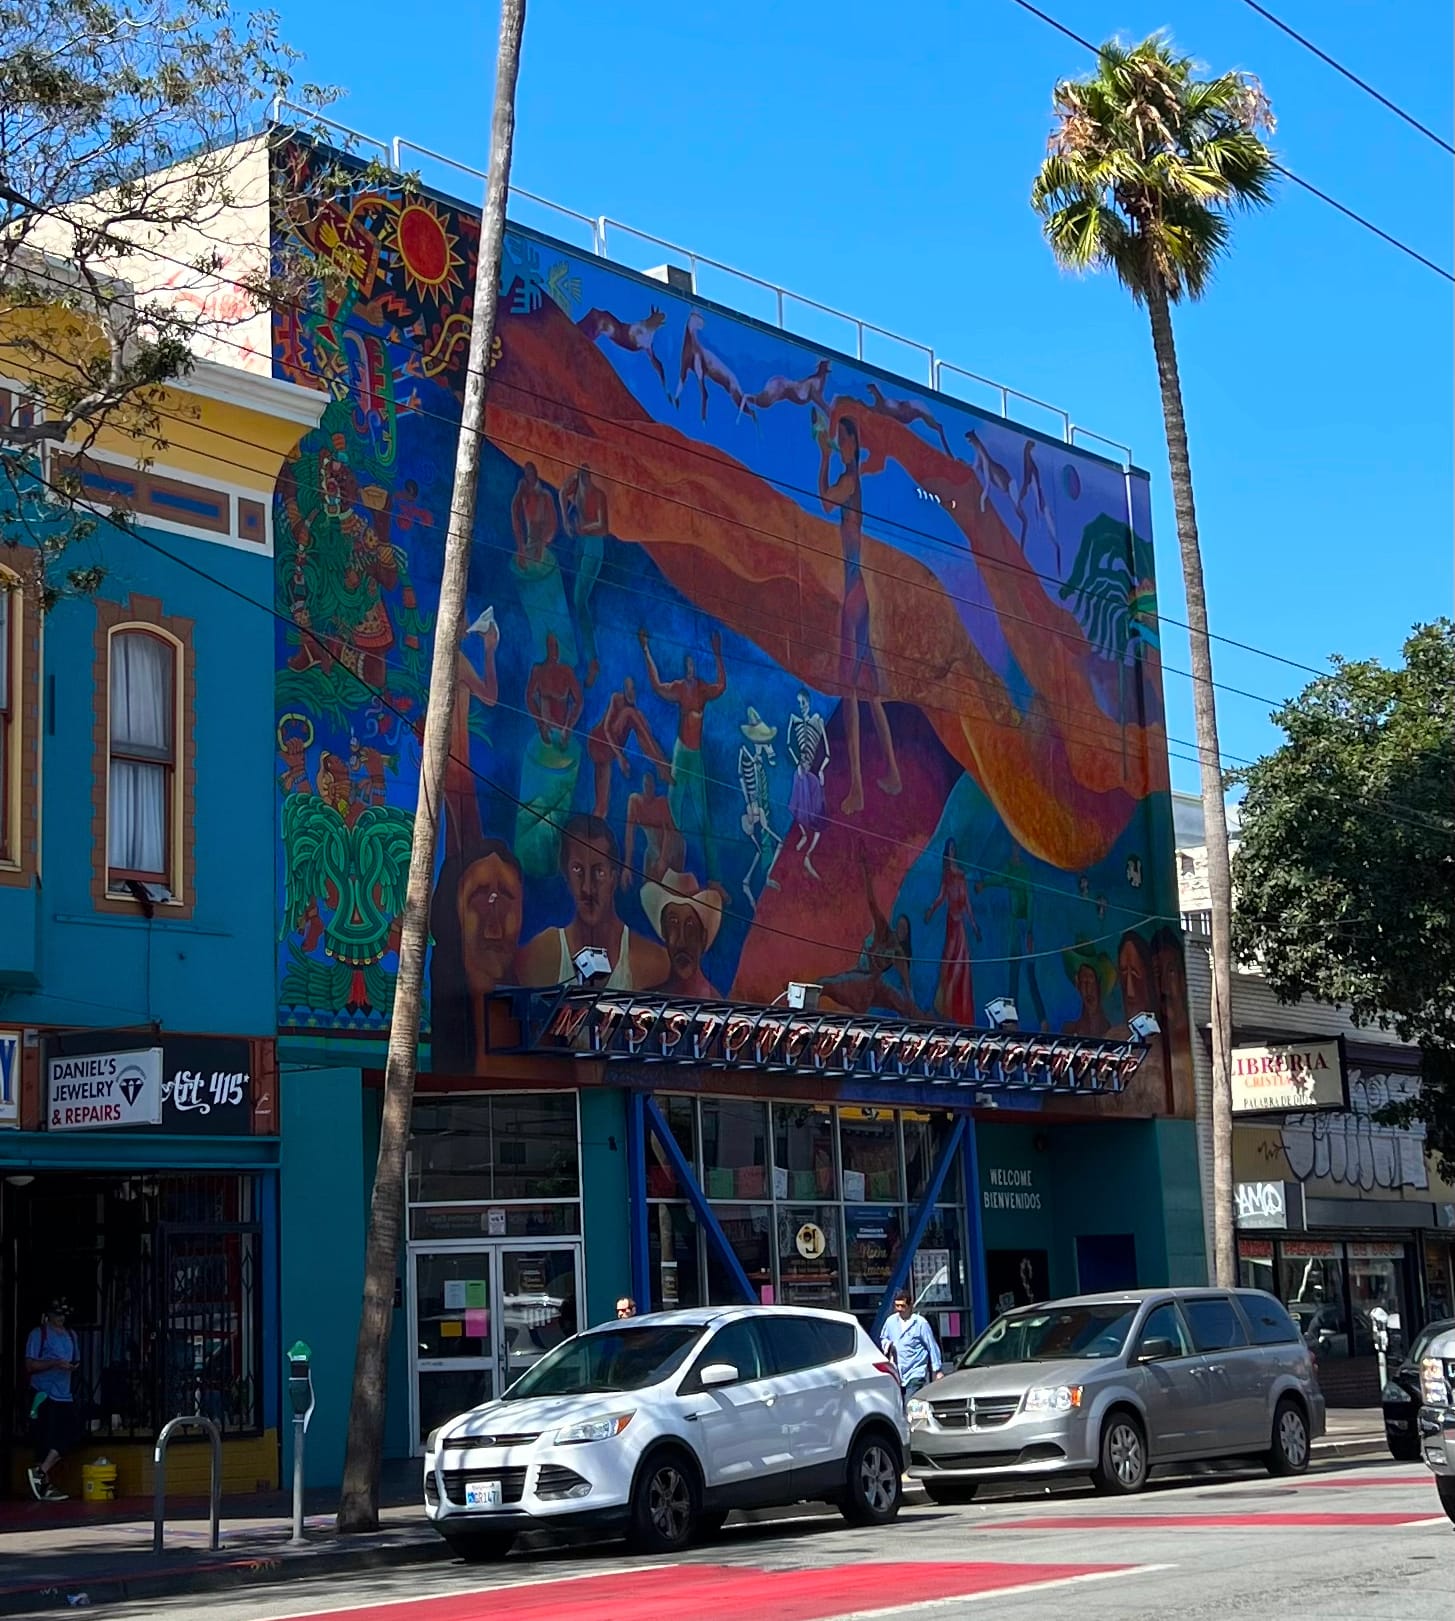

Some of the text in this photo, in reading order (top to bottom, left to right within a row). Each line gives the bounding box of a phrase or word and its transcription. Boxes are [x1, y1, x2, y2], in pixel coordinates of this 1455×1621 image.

[547, 1004, 1142, 1084] MISSION CULTURAL CENTER
[53, 1058, 117, 1080] DANIEL'S
[1232, 1052, 1329, 1076] IBRERIA
[52, 1080, 114, 1102] JEWELRY
[209, 1072, 244, 1105] 415
[1245, 1073, 1307, 1088] CRISTI
[51, 1104, 121, 1126] & REPAIRS
[990, 1169, 1032, 1186] WELCOME
[983, 1191, 1041, 1209] BIENVENIDOS
